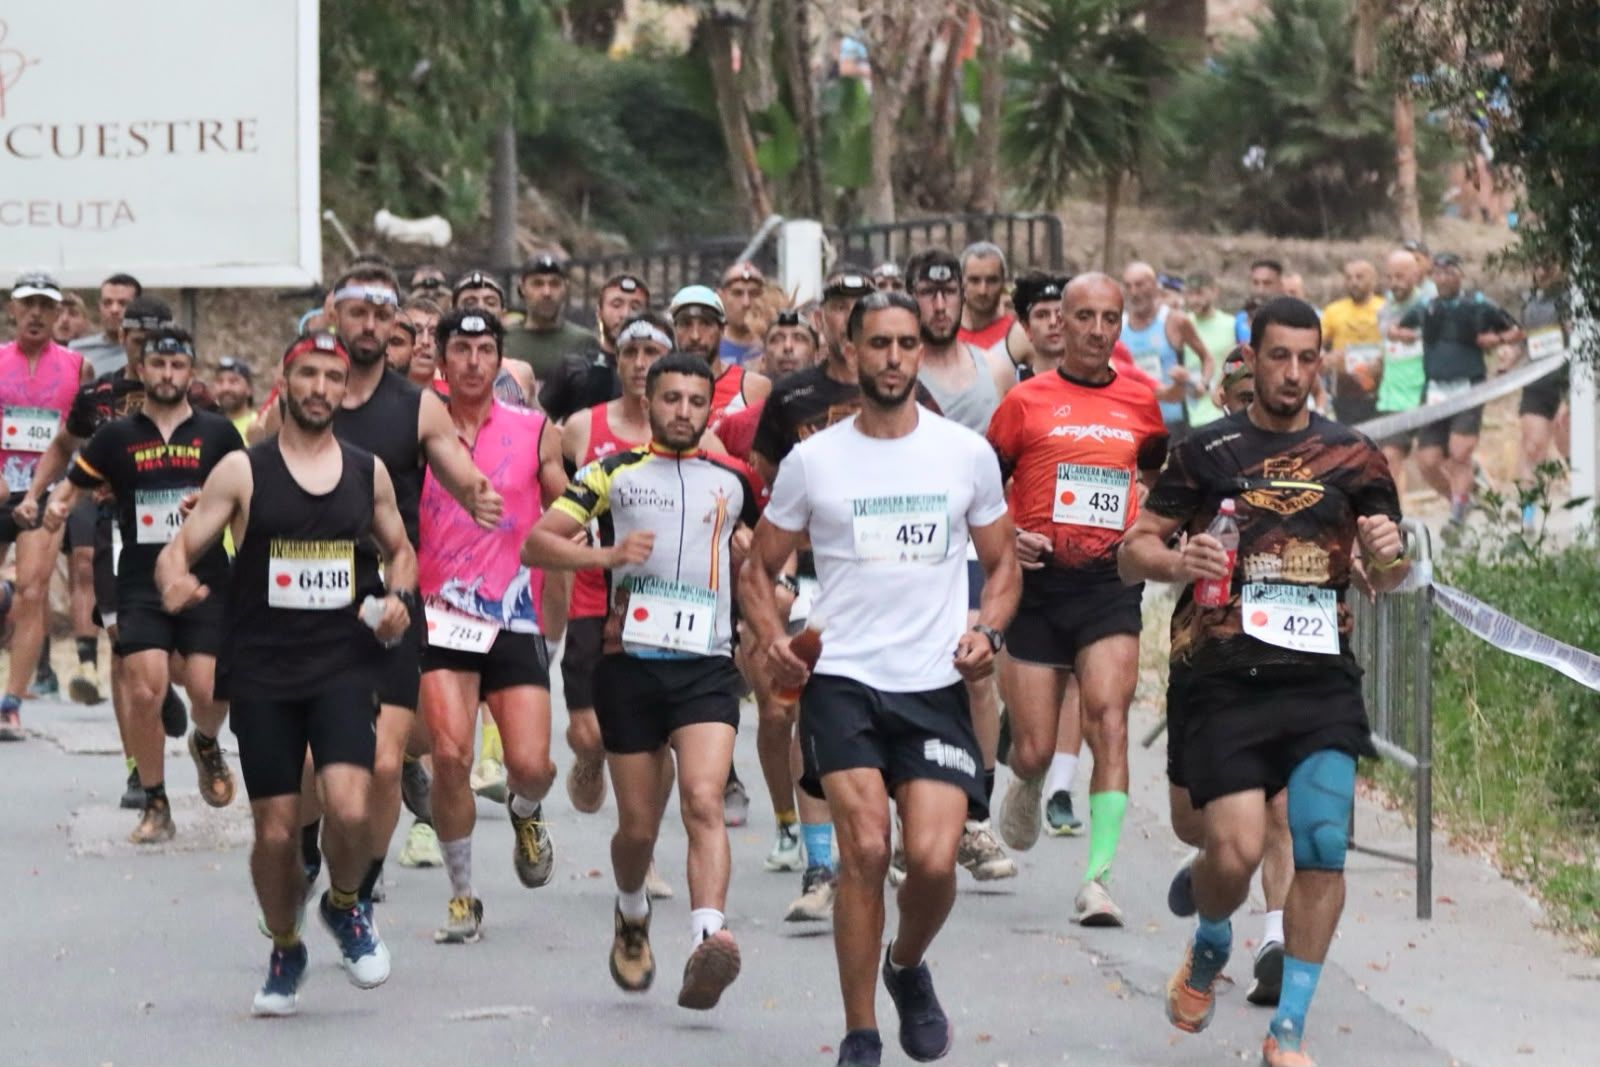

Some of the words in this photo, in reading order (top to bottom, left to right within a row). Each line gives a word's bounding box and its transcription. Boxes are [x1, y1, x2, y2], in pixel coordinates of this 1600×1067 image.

[5, 117, 259, 160] CUESTRE
[0, 199, 136, 231] CEUTA
[28, 426, 51, 439] 404
[1058, 464, 1070, 480] IX
[853, 498, 867, 516] IX
[1089, 492, 1119, 513] 433
[896, 523, 937, 545] 457
[632, 576, 646, 593] IX
[674, 611, 695, 632] 11
[1284, 616, 1324, 637] 422
